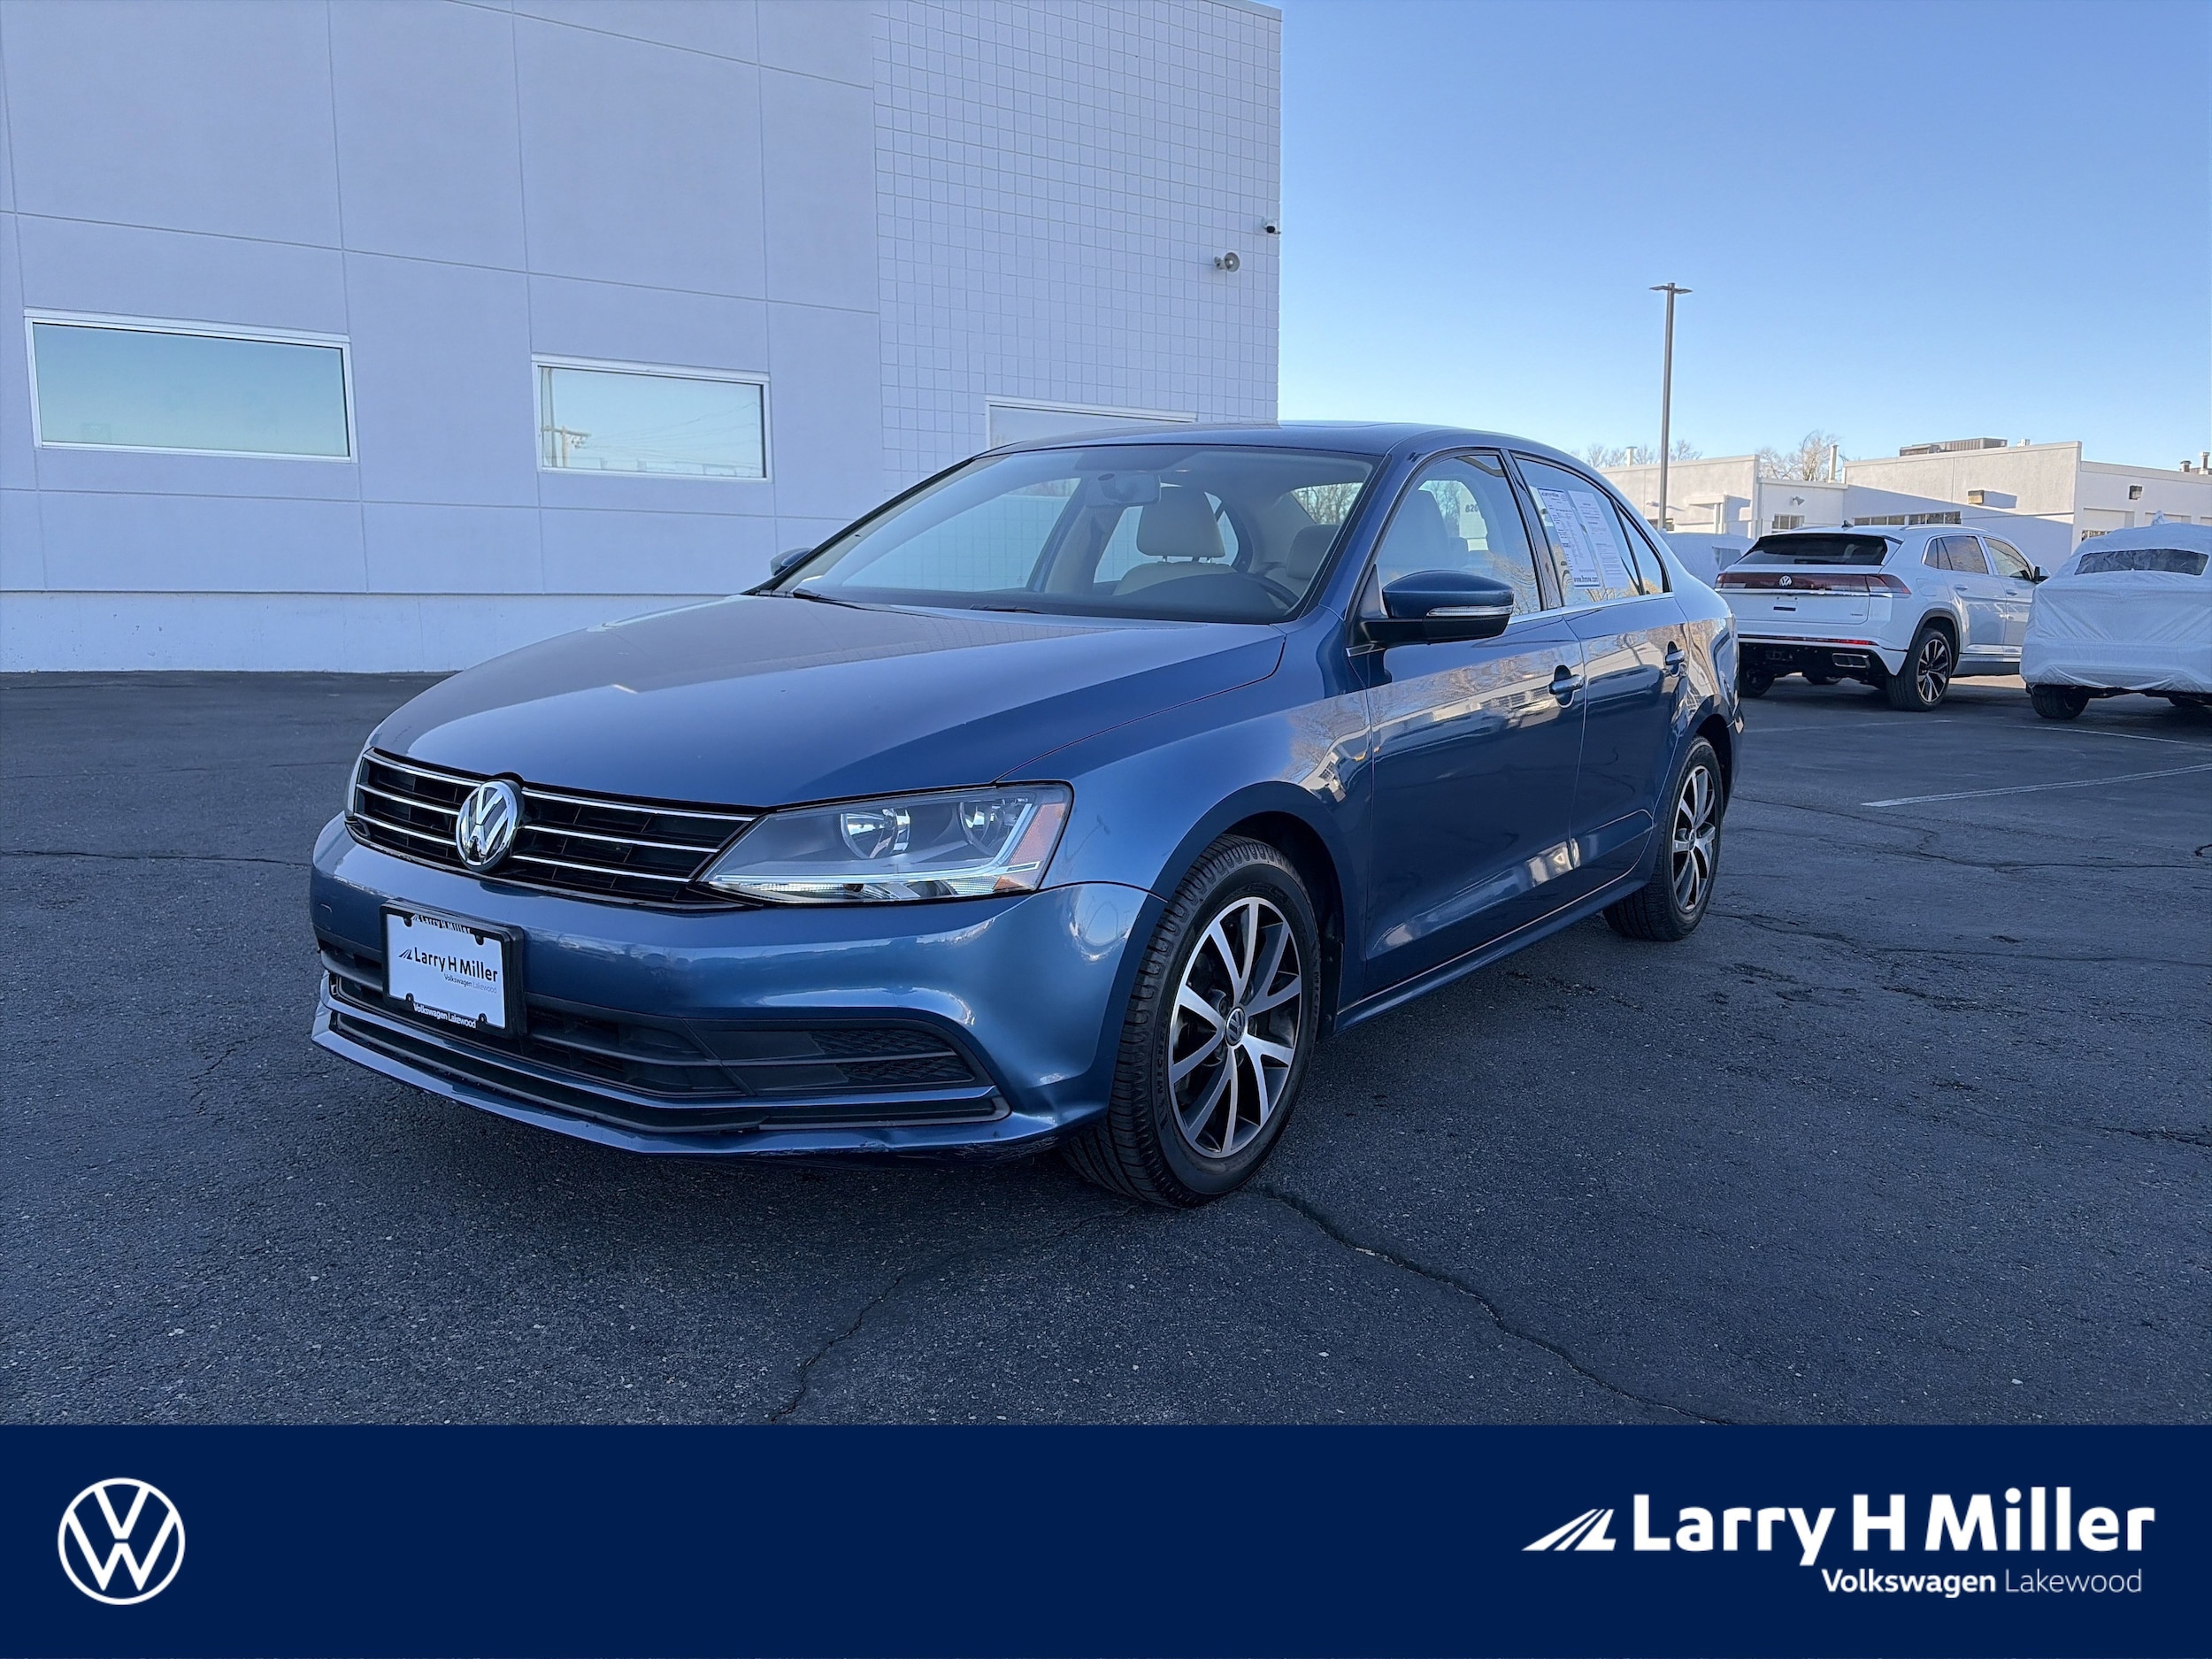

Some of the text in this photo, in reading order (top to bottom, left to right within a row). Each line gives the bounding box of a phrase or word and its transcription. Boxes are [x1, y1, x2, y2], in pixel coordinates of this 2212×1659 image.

[420, 915, 441, 927] Larry
[447, 922, 471, 934] Miller
[414, 947, 498, 982] Larry H Miller
[444, 973, 497, 993] Volkswagen Lakewood
[413, 1002, 476, 1028] Volkswagen Lakewood
